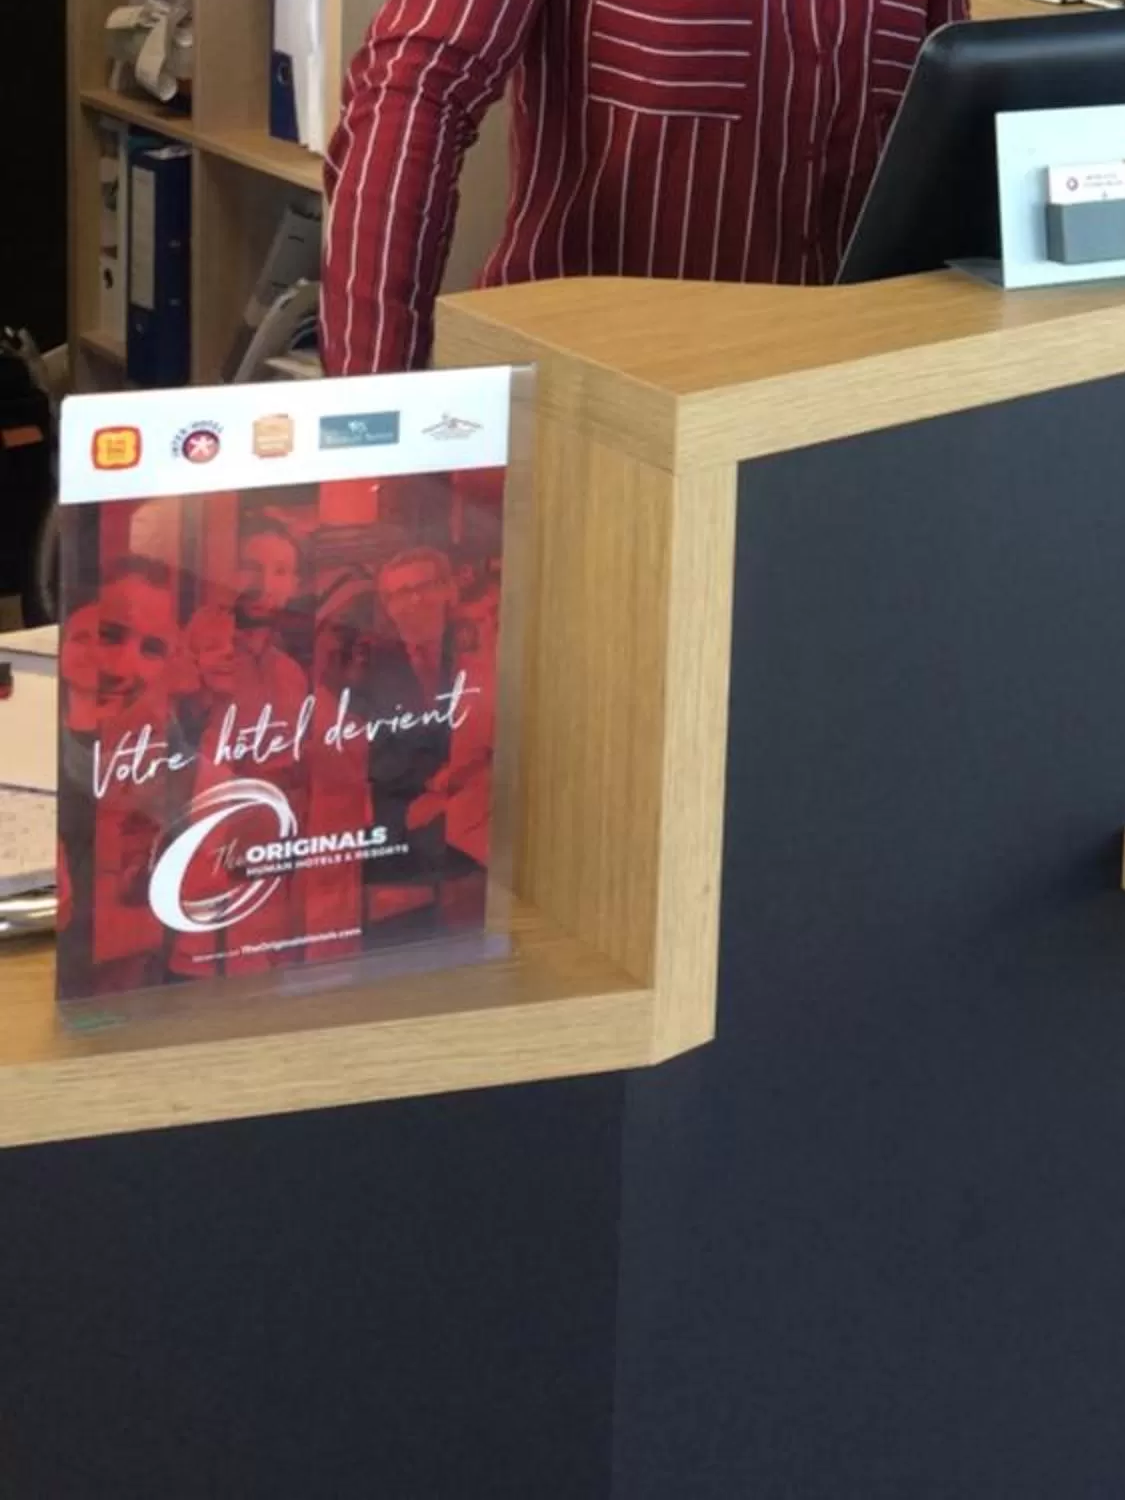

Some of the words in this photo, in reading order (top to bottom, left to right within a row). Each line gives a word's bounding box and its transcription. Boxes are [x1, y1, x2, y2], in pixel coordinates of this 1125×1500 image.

[93, 723, 196, 798] Votre
[214, 696, 315, 766] hôtel
[324, 670, 480, 753] devient
[246, 825, 388, 863] ORIGINALS
